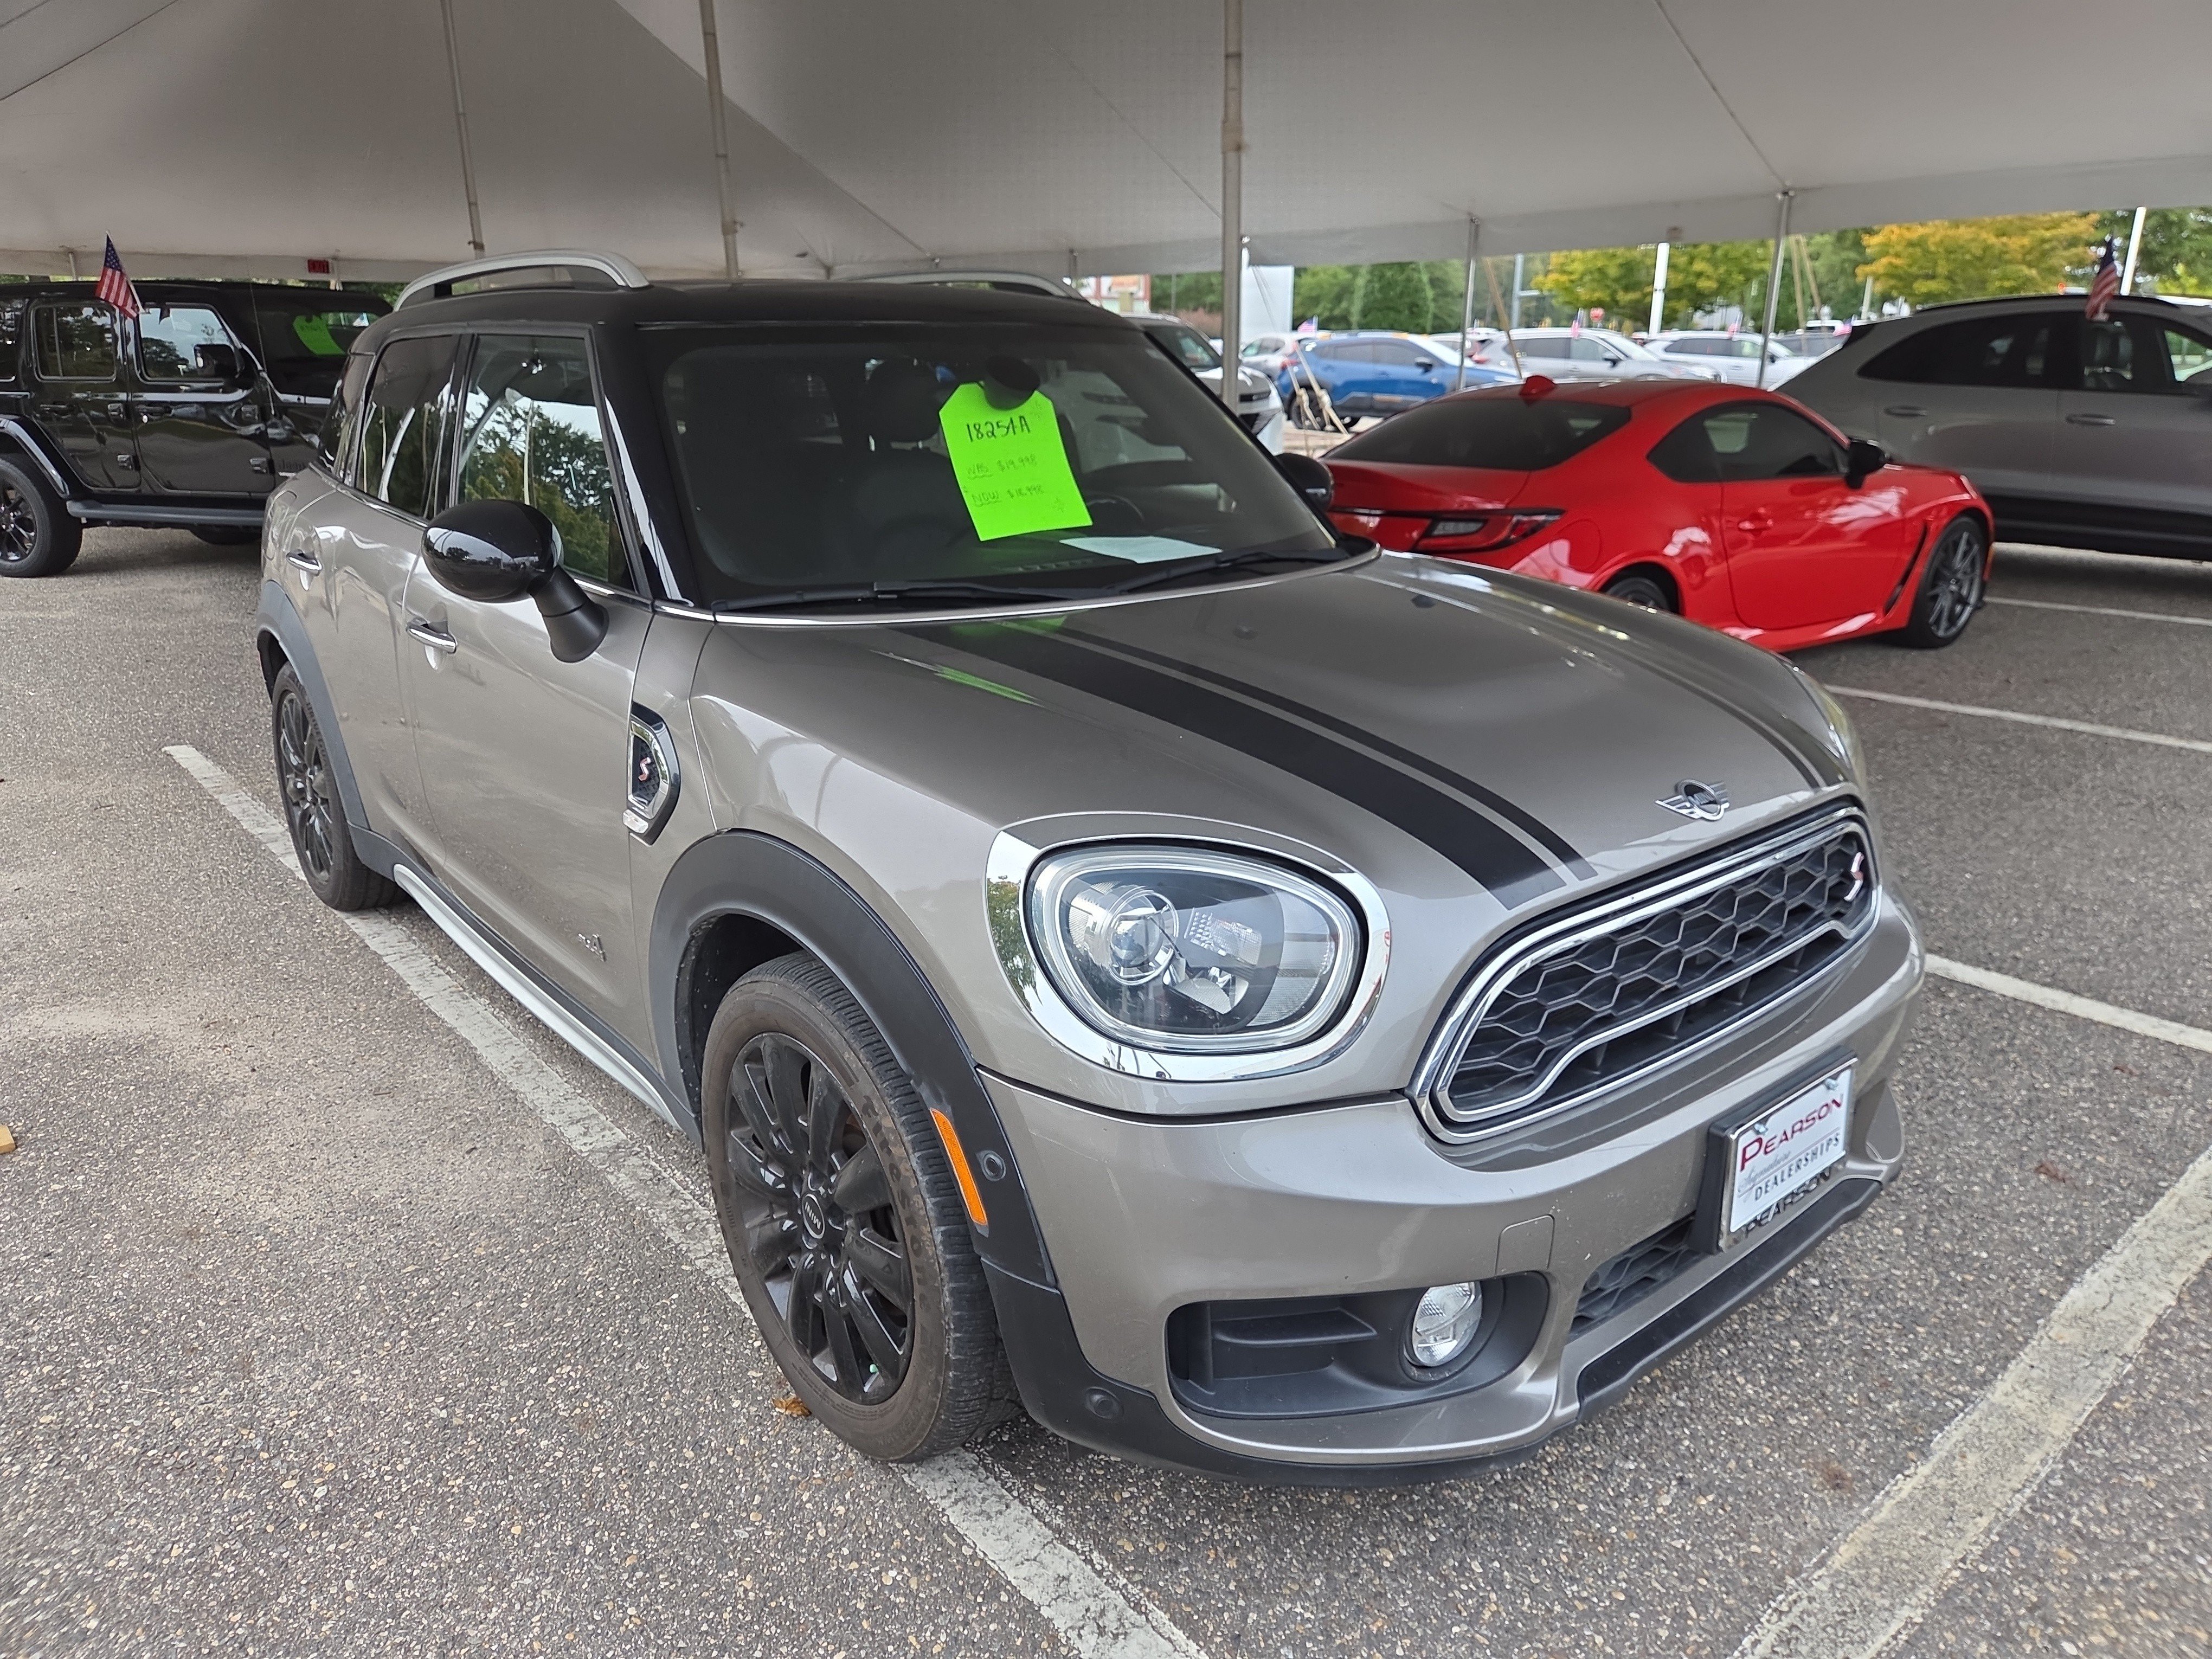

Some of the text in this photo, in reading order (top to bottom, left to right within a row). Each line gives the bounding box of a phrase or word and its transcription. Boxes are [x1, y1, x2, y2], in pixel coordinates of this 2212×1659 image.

[972, 491, 999, 503] NOW
[1740, 1094, 1843, 1171] PEARSON
[1754, 1132, 1840, 1201] DEALERSHIPS
[805, 1201, 821, 1230] MINI
